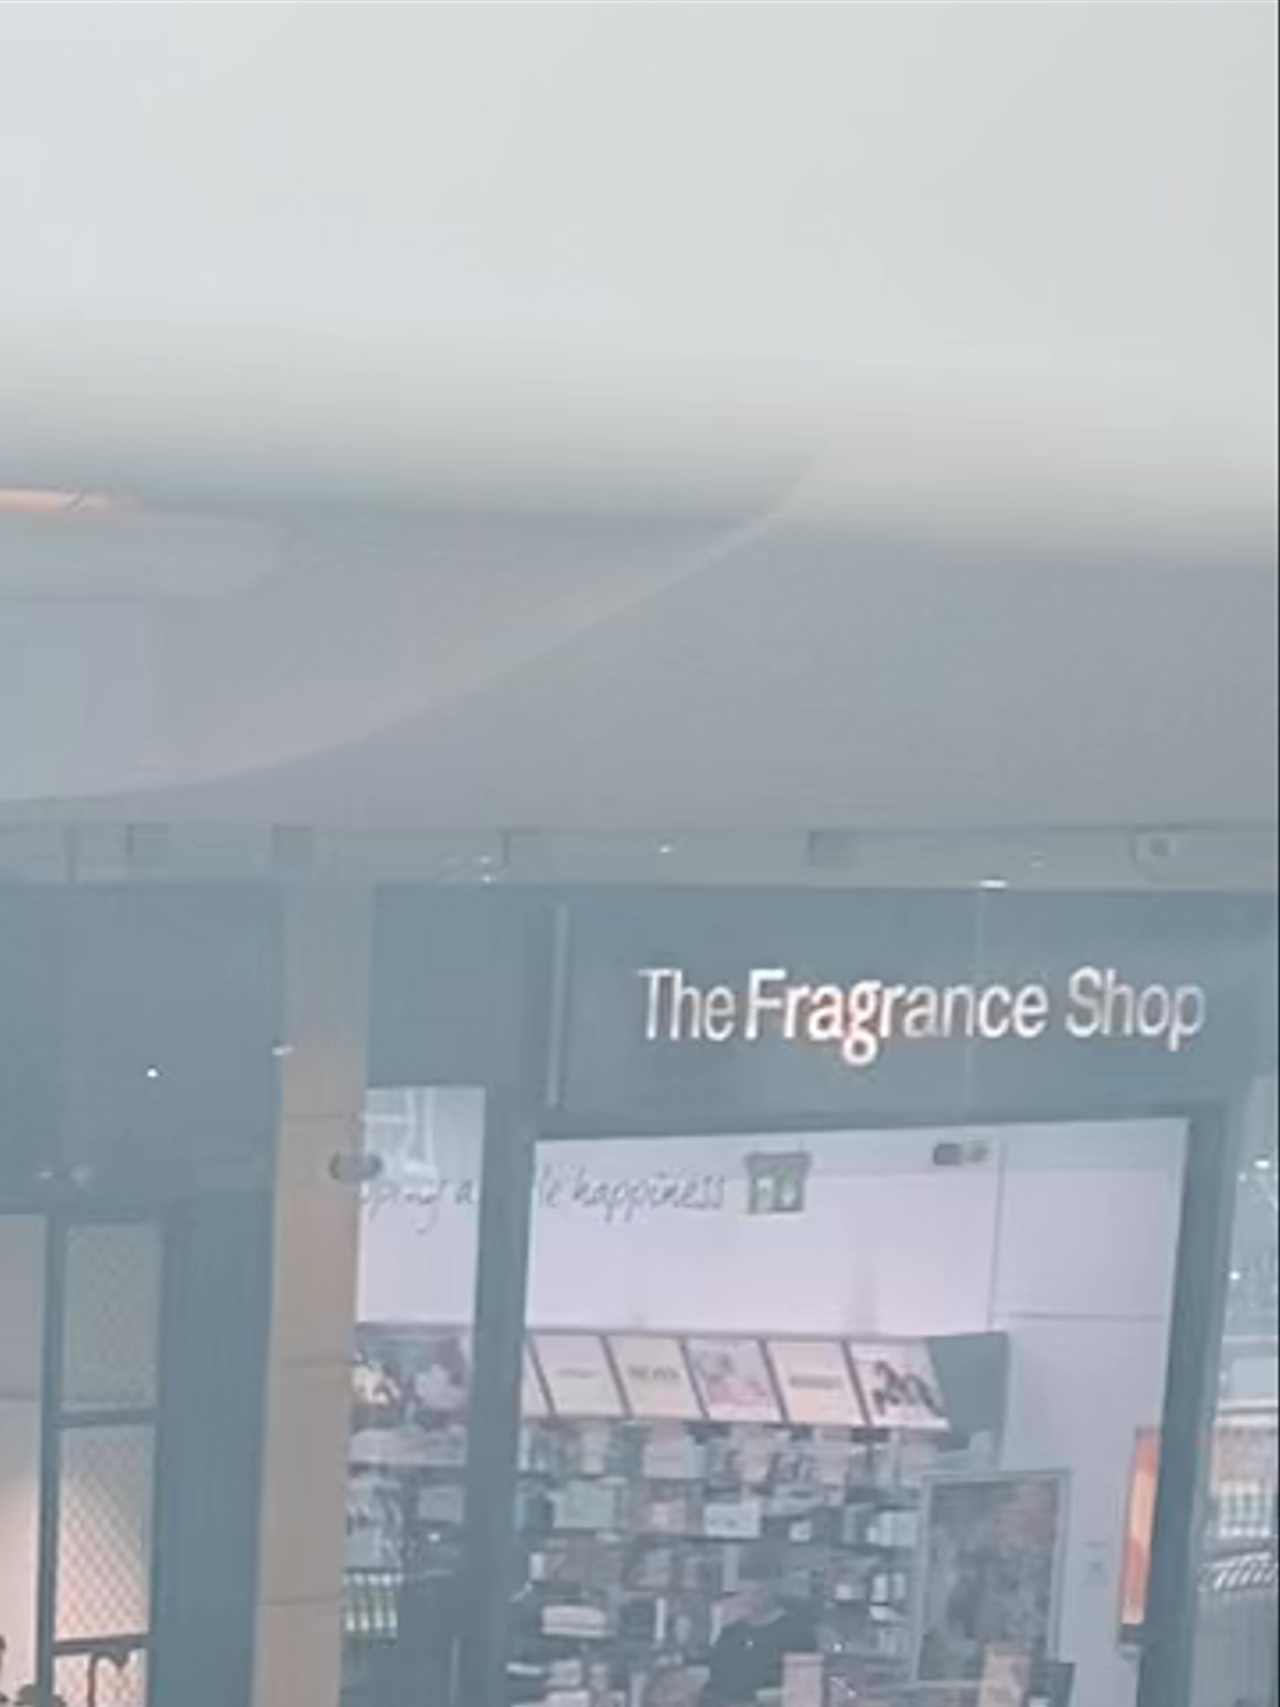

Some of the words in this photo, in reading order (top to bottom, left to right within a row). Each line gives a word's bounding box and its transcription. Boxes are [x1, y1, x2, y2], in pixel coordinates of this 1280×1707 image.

[635, 964, 736, 1042] The
[743, 966, 1050, 1067] Fragrance
[1063, 964, 1208, 1053] Shop
